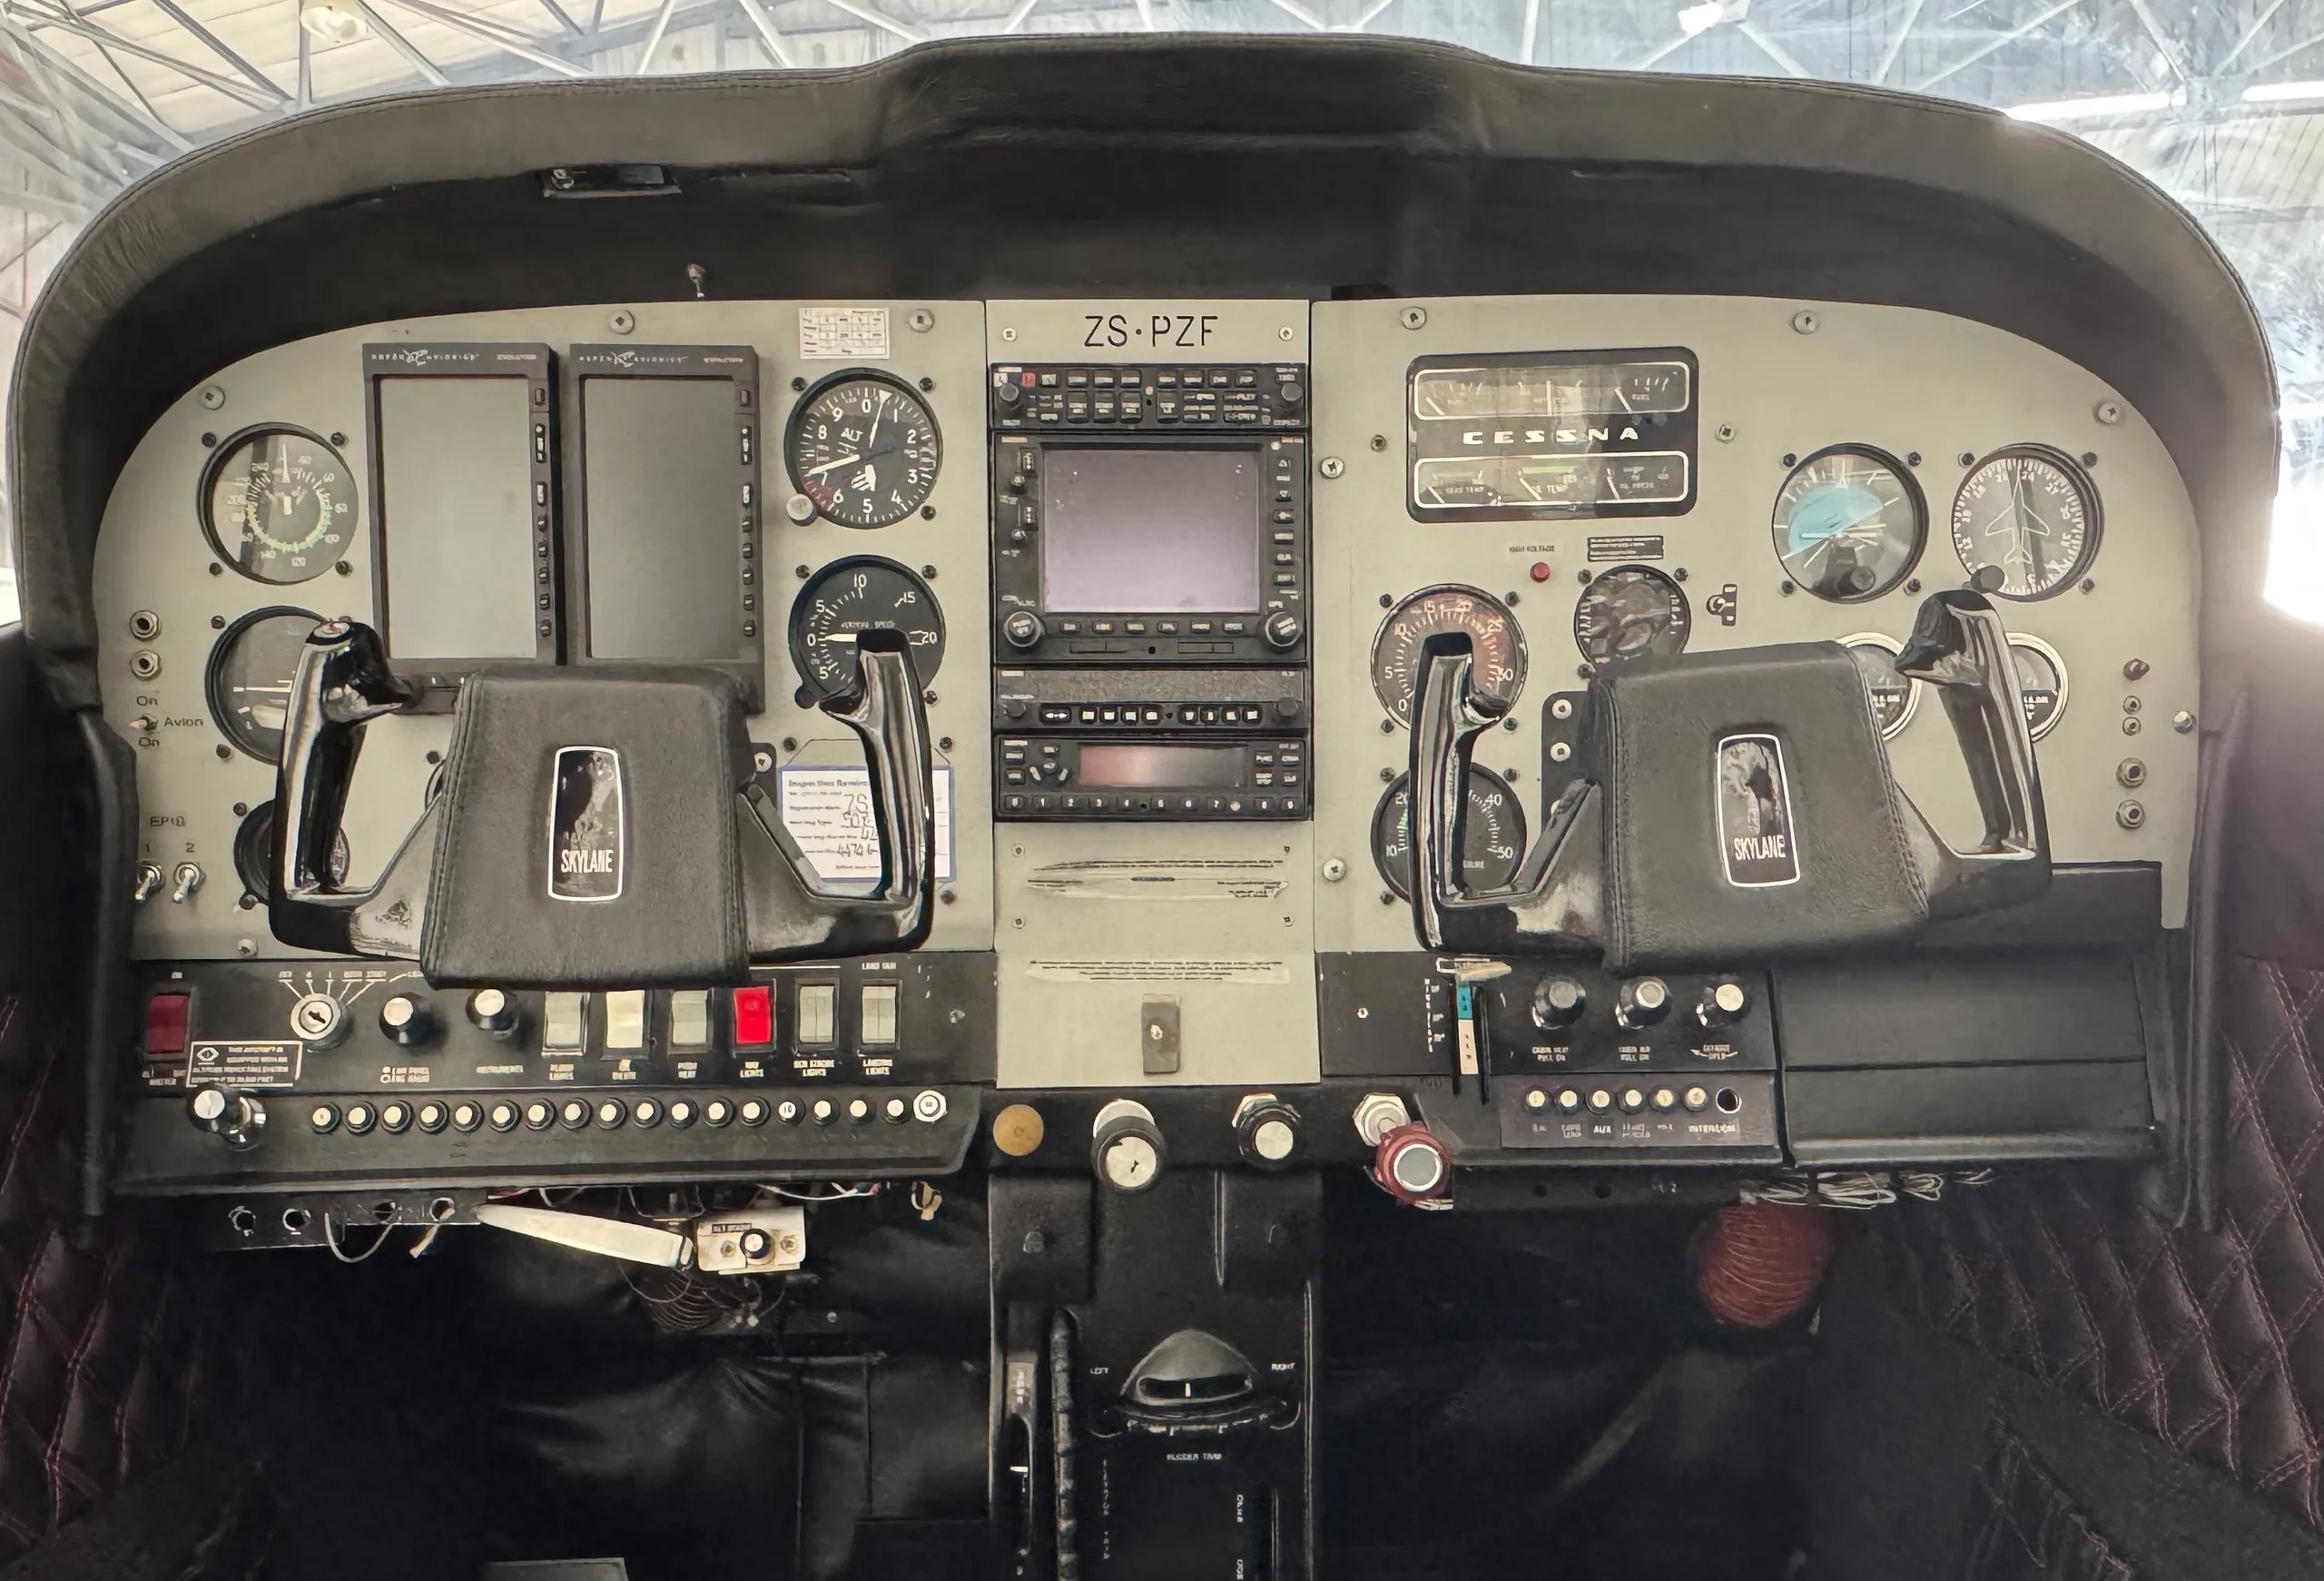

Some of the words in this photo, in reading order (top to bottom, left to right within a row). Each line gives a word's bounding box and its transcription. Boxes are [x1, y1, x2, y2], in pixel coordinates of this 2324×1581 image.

[862, 399, 872, 413] 0
[832, 408, 843, 422] 9
[893, 409, 897, 423] 1
[817, 425, 827, 440] 8
[841, 428, 863, 441] ALT
[907, 430, 917, 444] 2
[1462, 427, 1639, 445] CESSNA
[907, 469, 918, 484] 3
[833, 488, 844, 504] 6
[891, 489, 901, 505] 4
[862, 499, 873, 513] 5
[853, 574, 867, 588] 10
[903, 591, 915, 603] 15
[815, 599, 826, 613] 5
[1424, 600, 1435, 613] 15
[807, 634, 816, 647] 0
[922, 631, 938, 644] 20
[819, 667, 829, 679] 5
[1384, 667, 1393, 679] 5
[136, 696, 158, 707] On
[1398, 699, 1408, 711] 0
[138, 737, 160, 747] On
[1485, 794, 1502, 806] 40
[186, 843, 195, 853] 2
[1385, 845, 1397, 856] 10
[1497, 846, 1513, 859] 50
[1734, 835, 1787, 861] SKYLANE
[561, 850, 614, 873] SKYLANE
